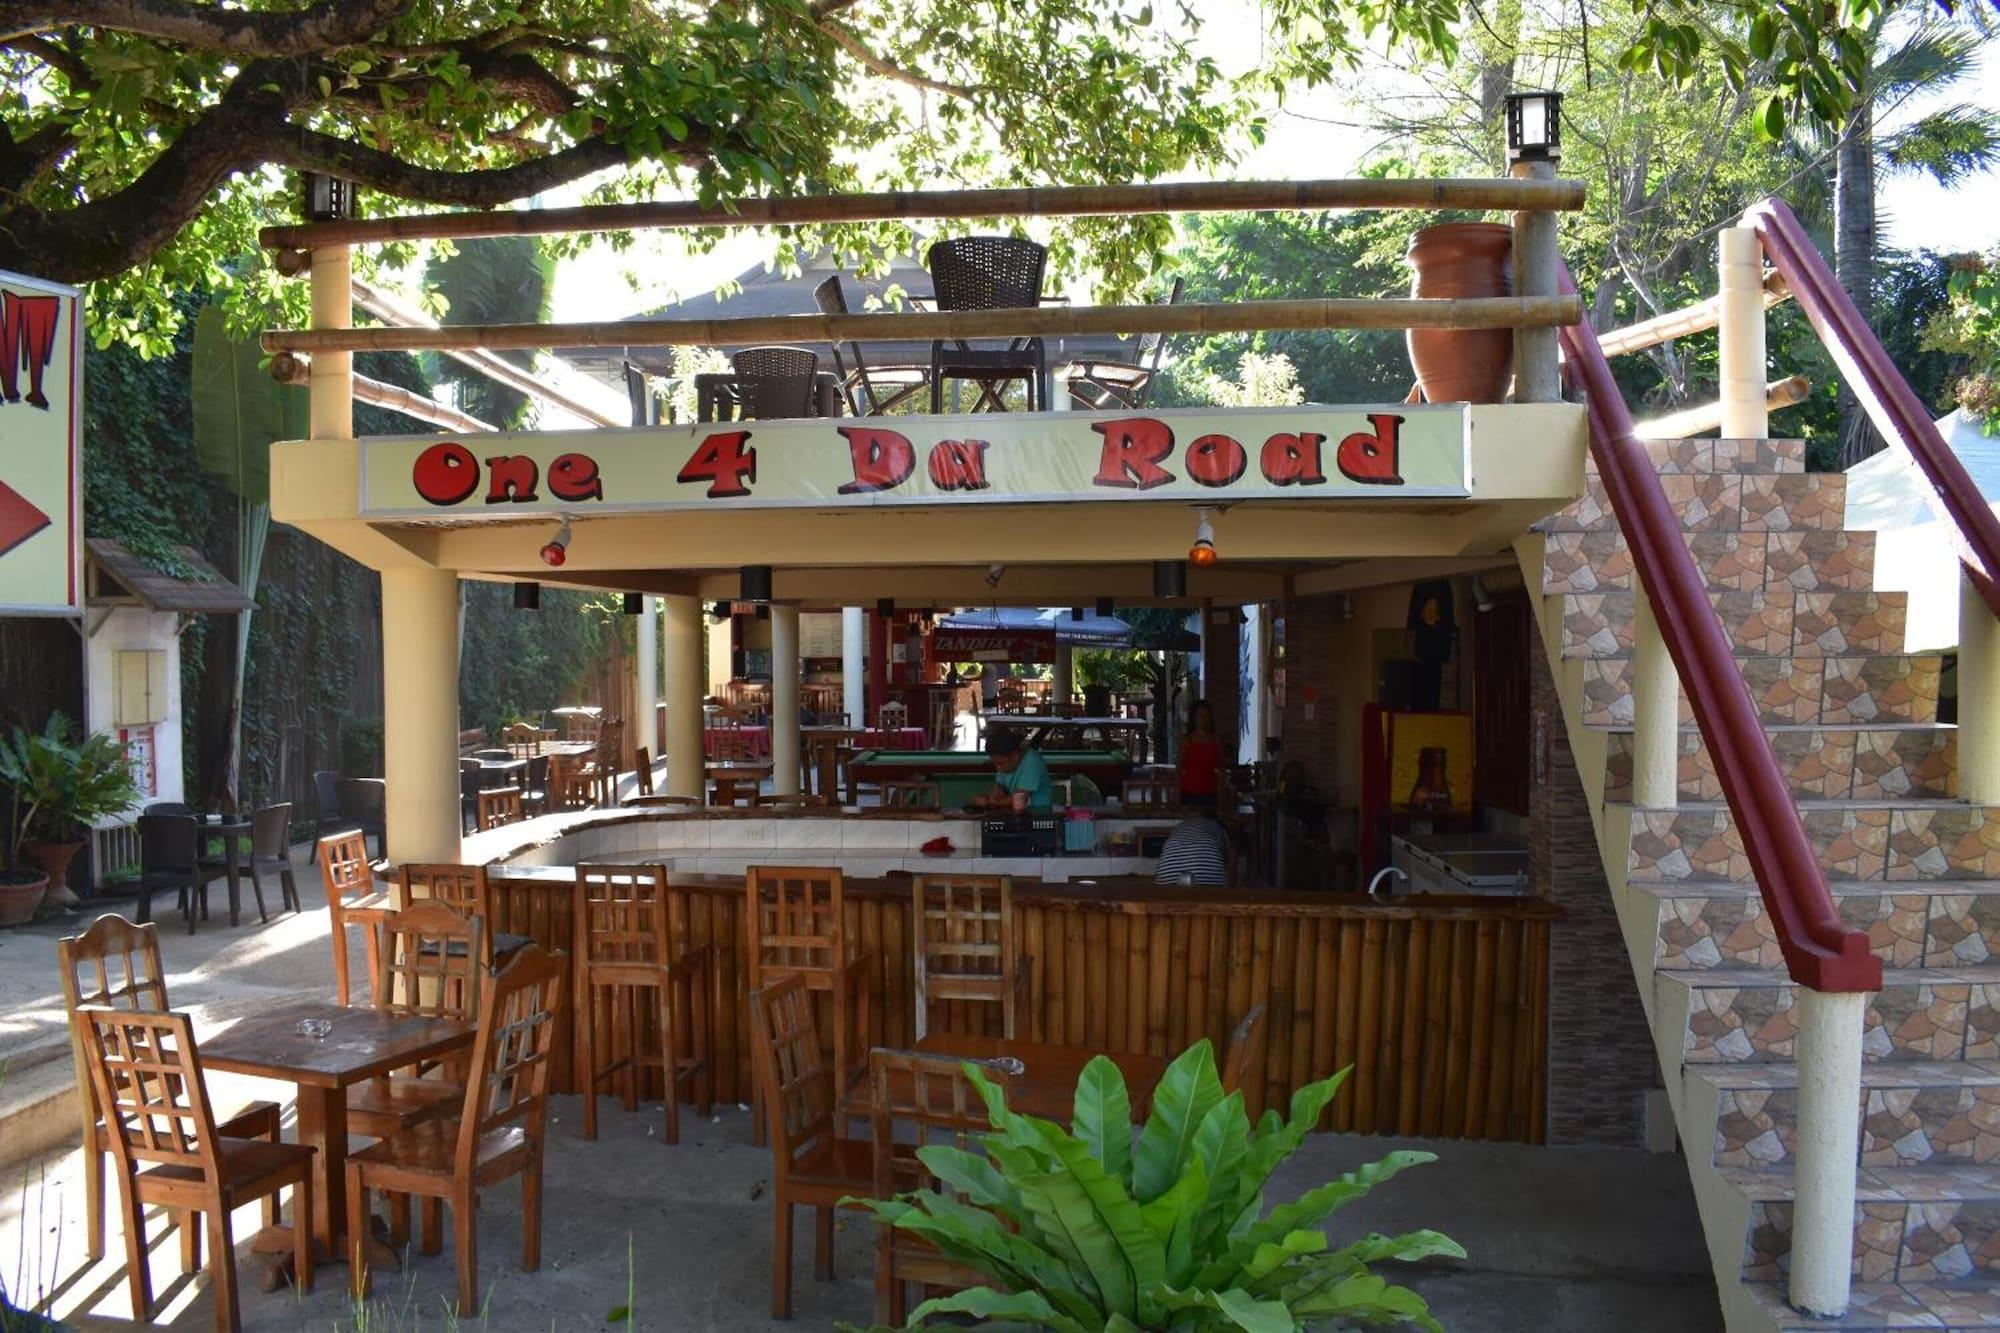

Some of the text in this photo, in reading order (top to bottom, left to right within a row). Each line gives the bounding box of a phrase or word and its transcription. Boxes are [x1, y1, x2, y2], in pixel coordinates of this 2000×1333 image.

[413, 413, 1406, 506] One 4 Da Road
